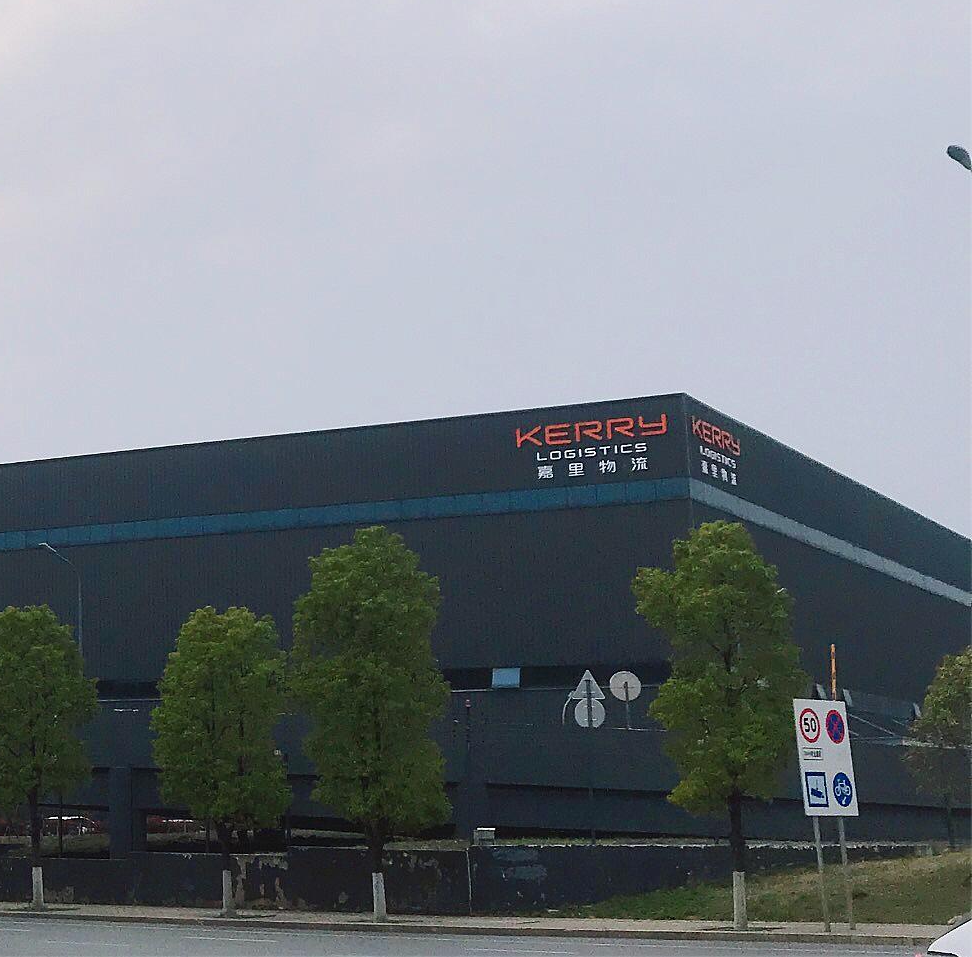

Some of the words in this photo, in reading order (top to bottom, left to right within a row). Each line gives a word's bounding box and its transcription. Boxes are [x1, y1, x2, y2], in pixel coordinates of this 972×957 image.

[515, 413, 668, 448] KERRY
[692, 415, 741, 456] KERRY
[536, 442, 648, 461] LOGISTICS
[537, 456, 649, 480] 嘉里物流
[803, 718, 817, 732] 50
